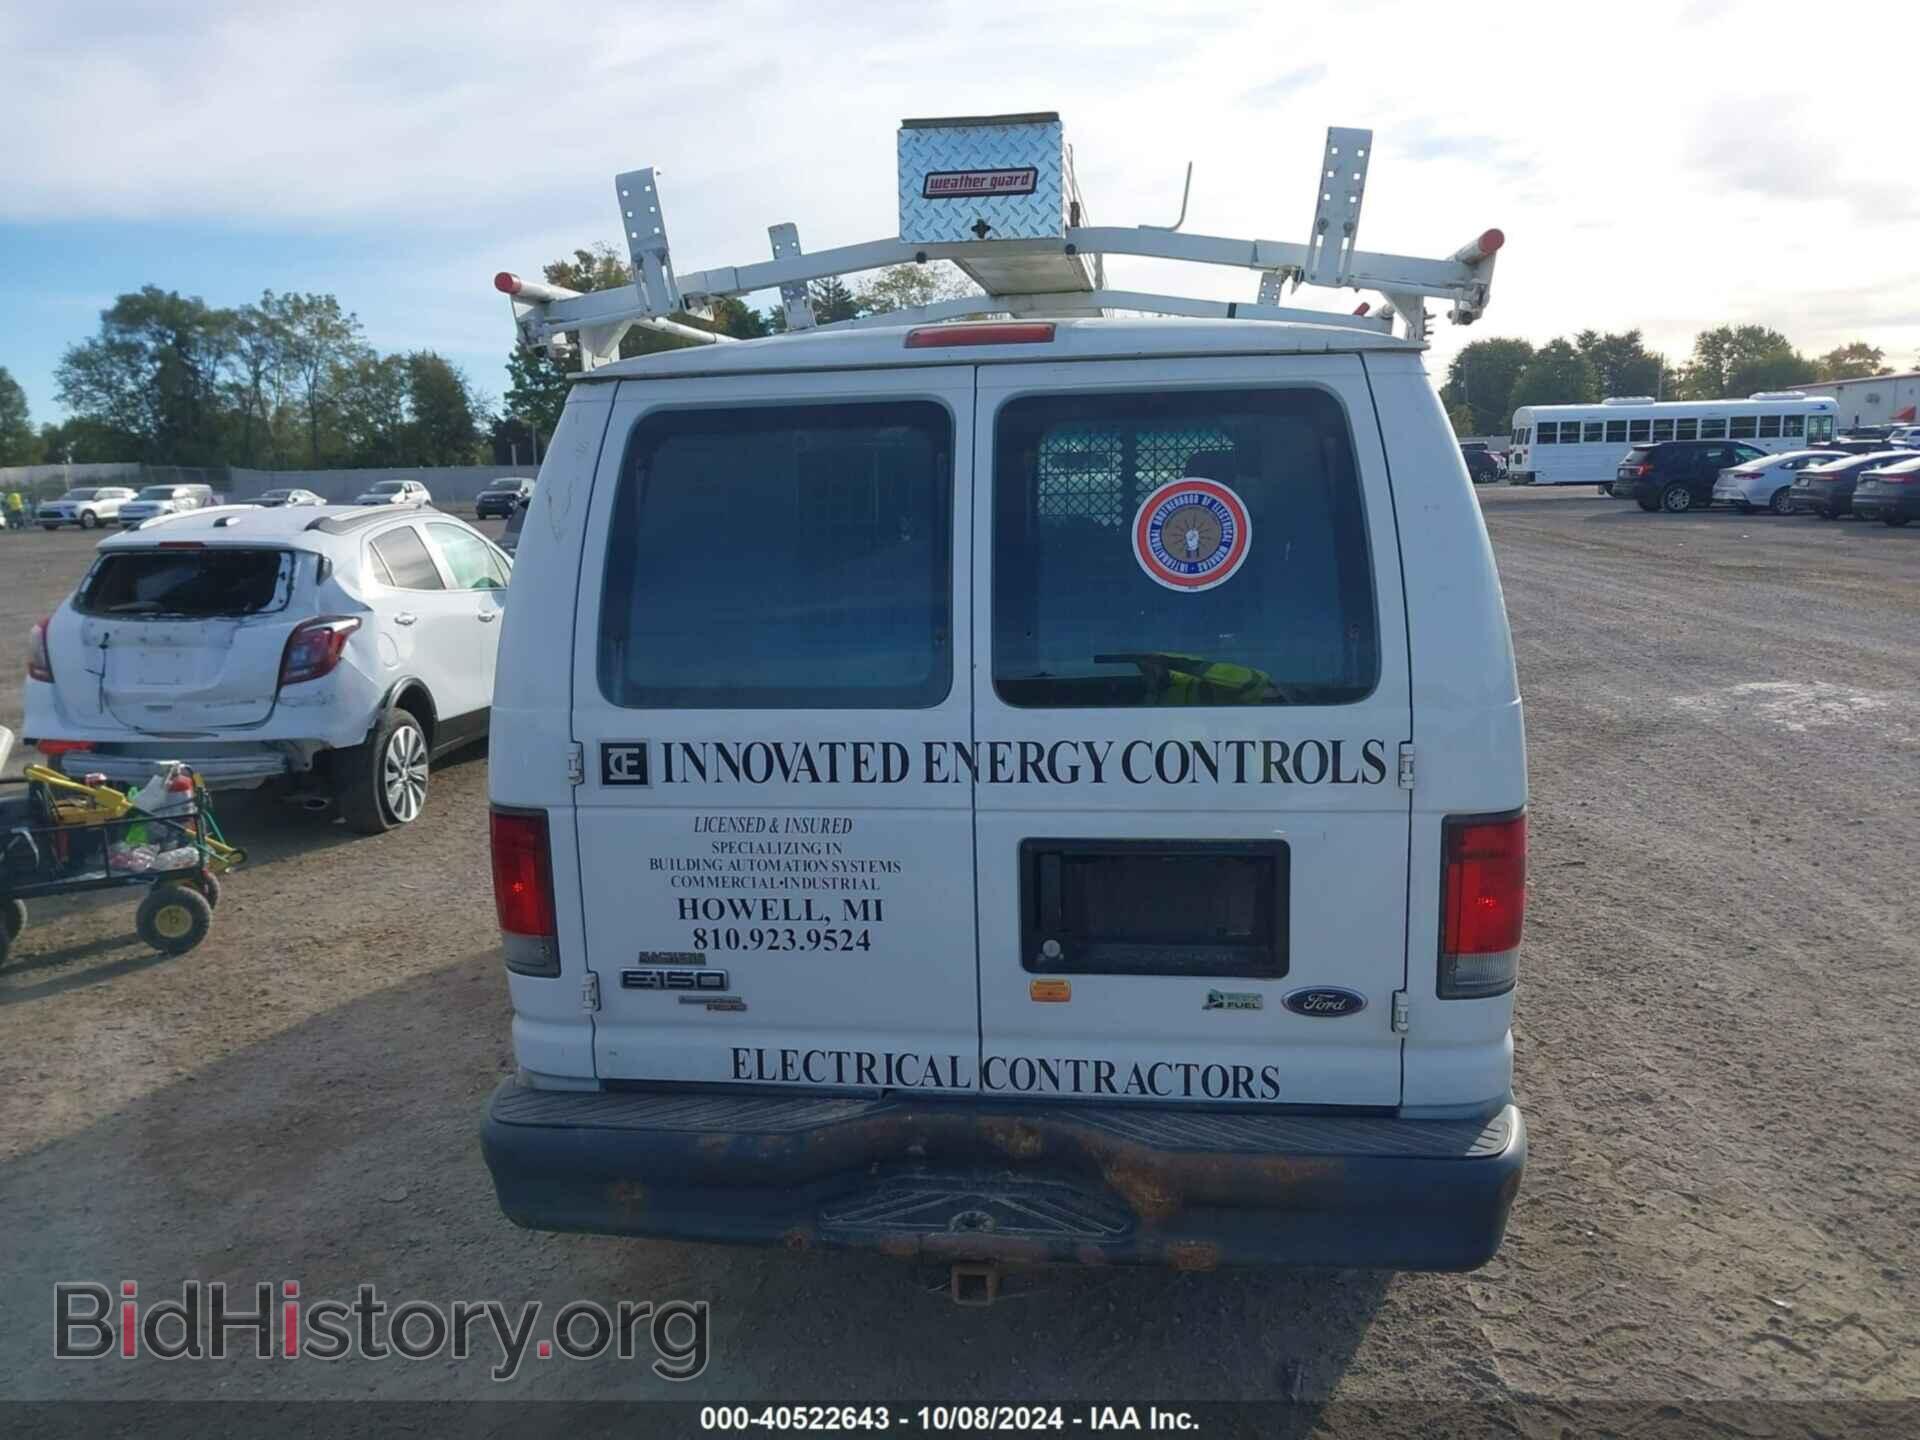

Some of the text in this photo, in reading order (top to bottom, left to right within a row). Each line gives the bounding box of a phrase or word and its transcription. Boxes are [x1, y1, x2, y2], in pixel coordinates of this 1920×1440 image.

[930, 172, 1030, 189] weather guard
[660, 738, 1387, 785] INNOVATED ENERGY CONTROLS
[694, 816, 853, 835] LICENSED & INSURED
[711, 841, 843, 855] SPECIALIZING IN
[649, 857, 902, 873] BUILDING AUTOMATION SYSTEMS
[677, 897, 884, 926] HOWELL, MI
[692, 927, 871, 952] 810.923.9524
[1303, 993, 1346, 1010] Ford
[730, 1047, 1281, 1100] ELECTRICAL CONTRACTORS
